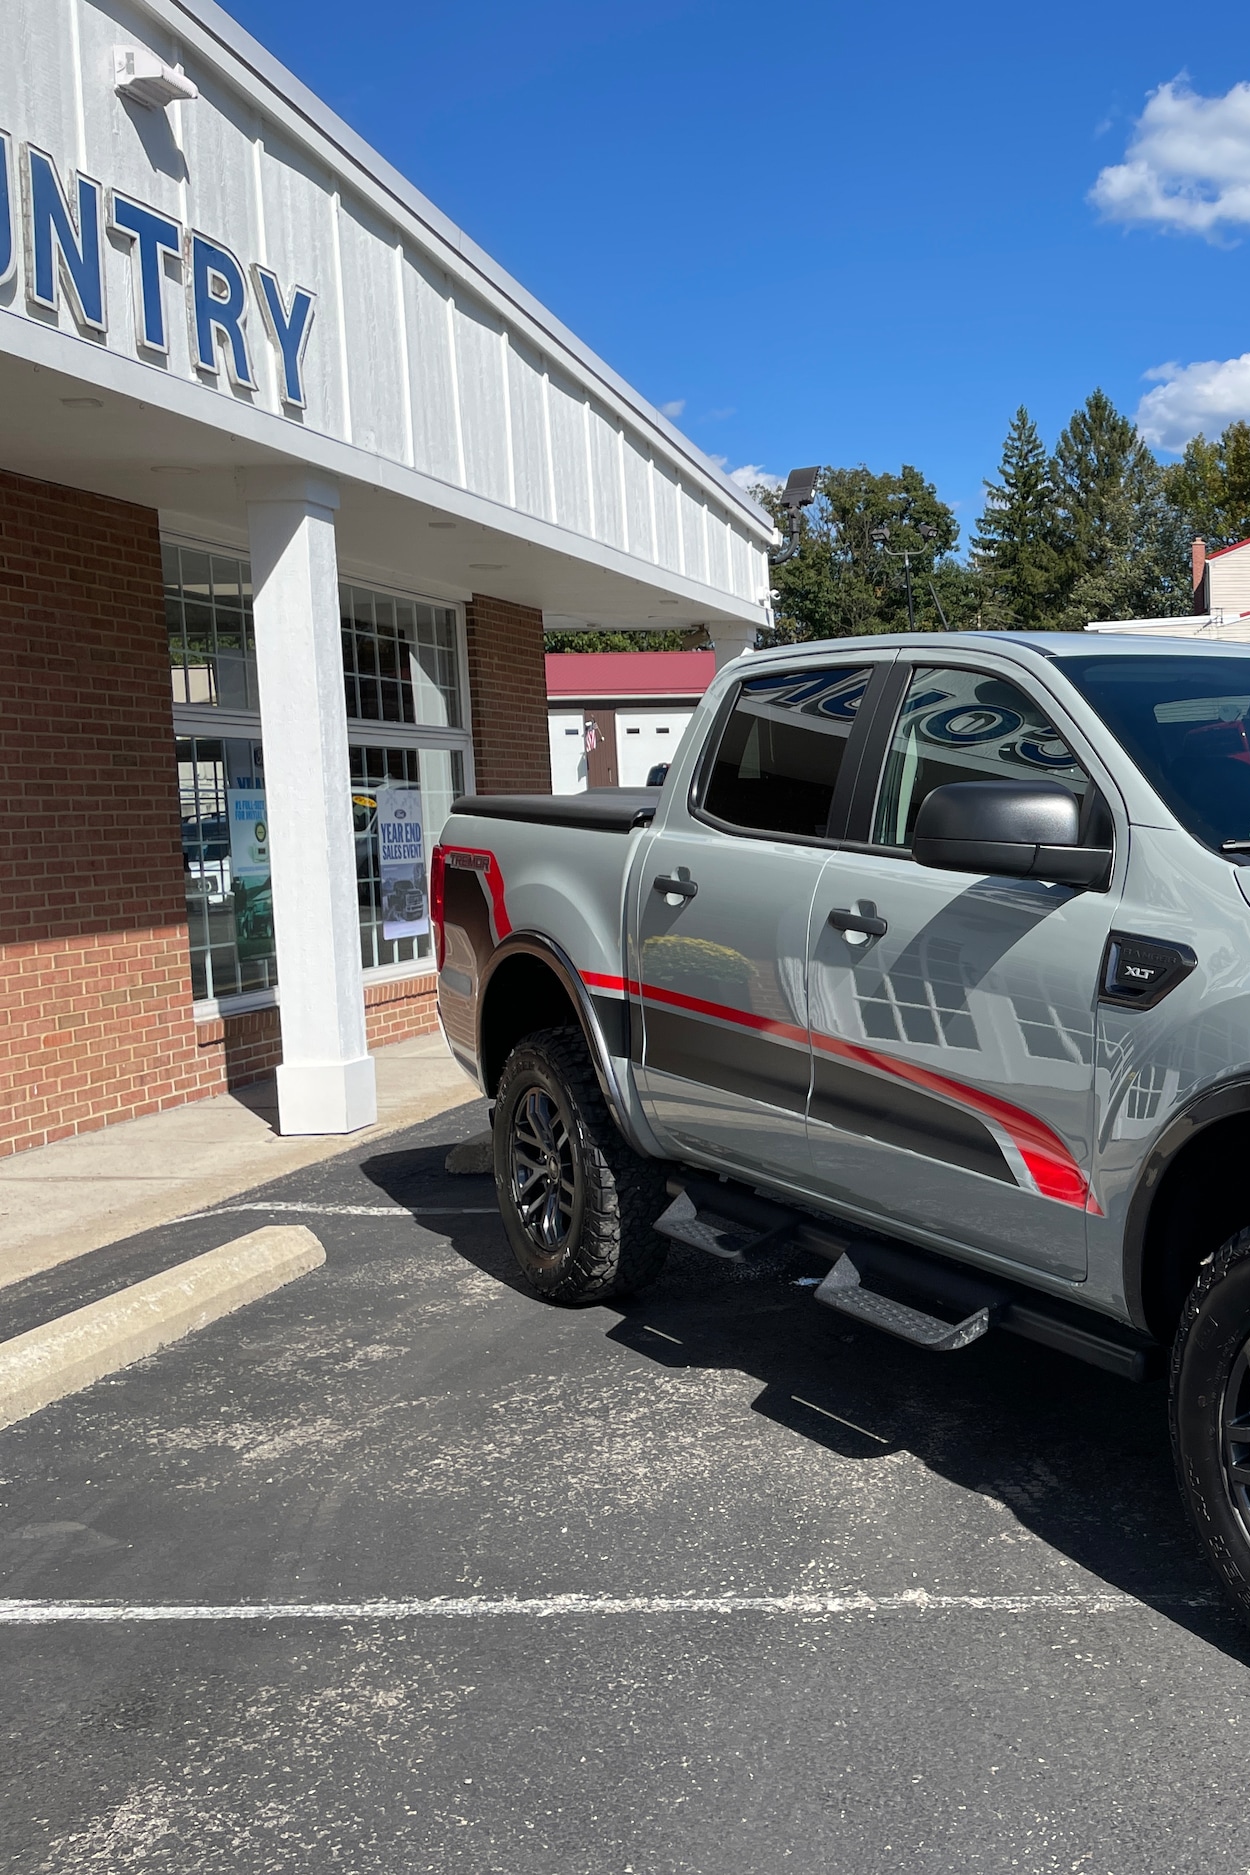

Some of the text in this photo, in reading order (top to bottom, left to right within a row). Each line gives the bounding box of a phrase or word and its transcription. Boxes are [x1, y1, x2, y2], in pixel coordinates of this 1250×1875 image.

[0, 128, 318, 410] NTRY
[381, 822, 421, 843] YEAR END
[382, 844, 422, 860] SALES EVENT
[451, 852, 489, 871] TREMOR
[1123, 947, 1177, 964] RANGER
[1124, 965, 1155, 980] XLT
